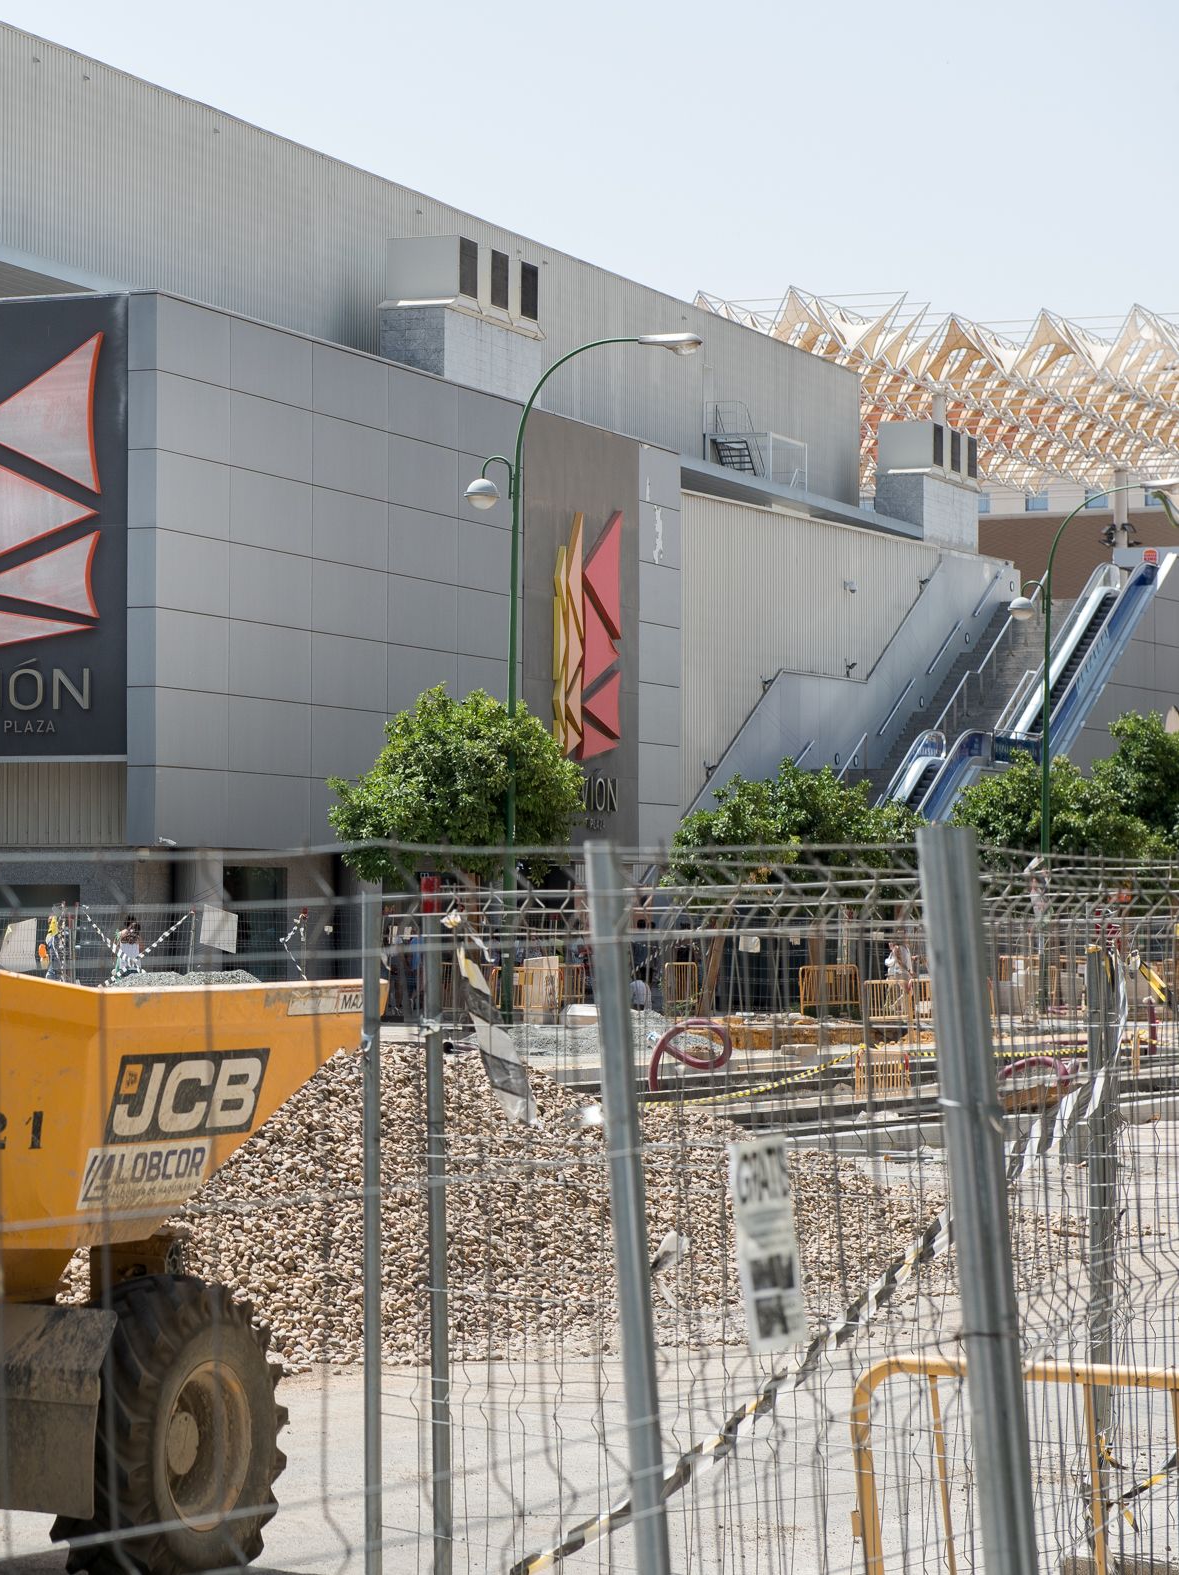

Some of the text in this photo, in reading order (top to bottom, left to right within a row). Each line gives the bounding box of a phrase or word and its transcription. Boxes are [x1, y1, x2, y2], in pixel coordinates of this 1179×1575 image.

[3, 719, 56, 733] PLAZA
[582, 769, 619, 812] VIÓN
[112, 1057, 263, 1137] JCB
[114, 1146, 207, 1185] LOBCOR
